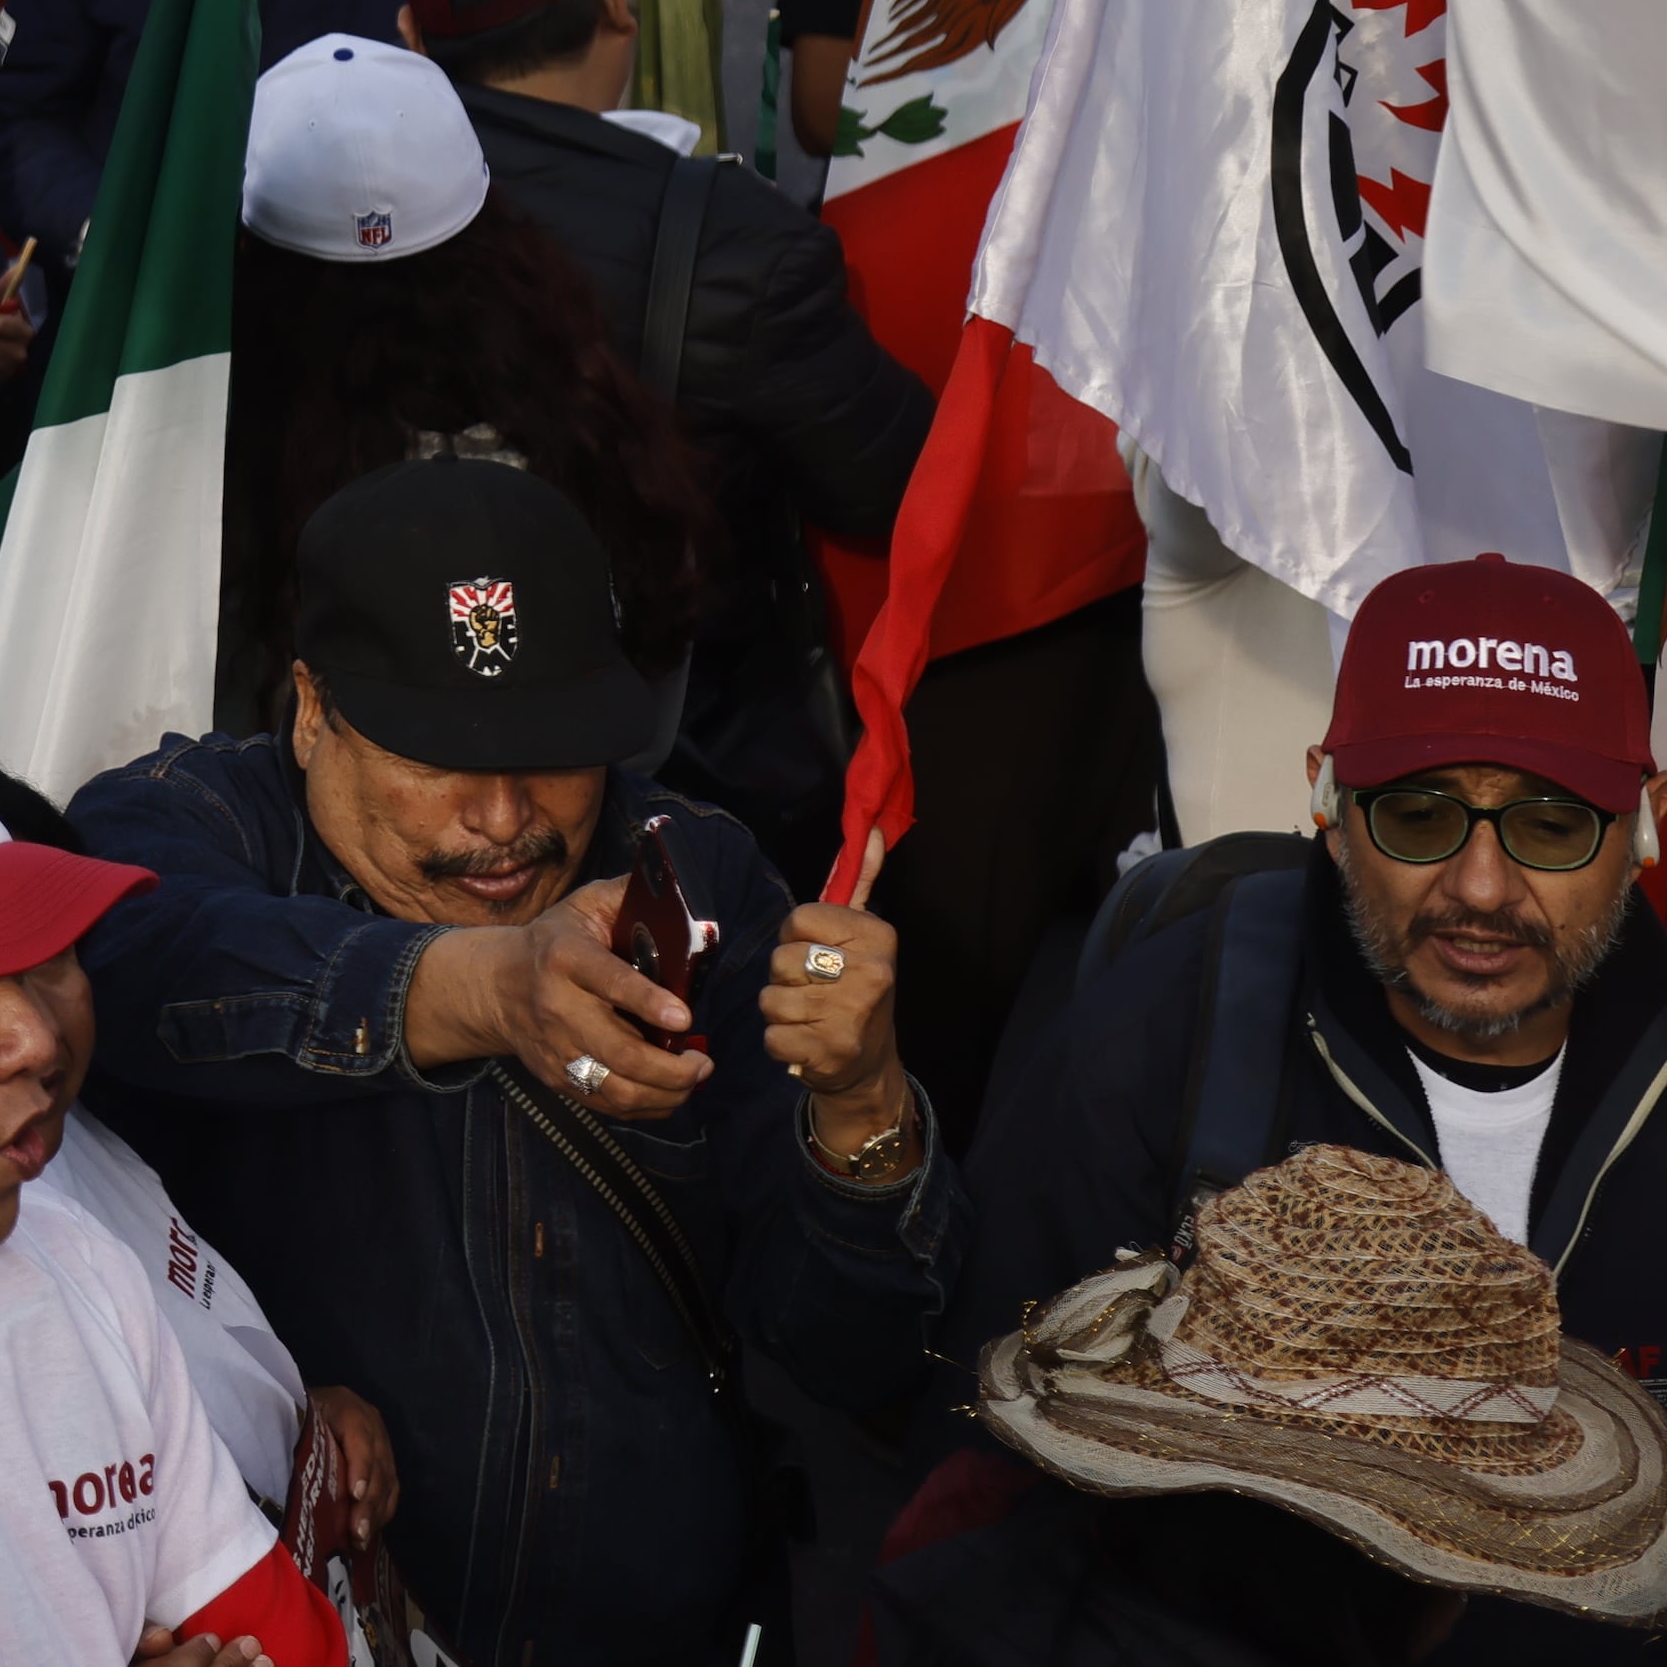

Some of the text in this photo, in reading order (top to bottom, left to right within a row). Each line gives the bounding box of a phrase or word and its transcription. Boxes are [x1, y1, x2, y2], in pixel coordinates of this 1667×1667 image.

[359, 224, 390, 245] NFL
[1406, 636, 1578, 682] morena
[1404, 675, 1580, 702] La esperanza de México
